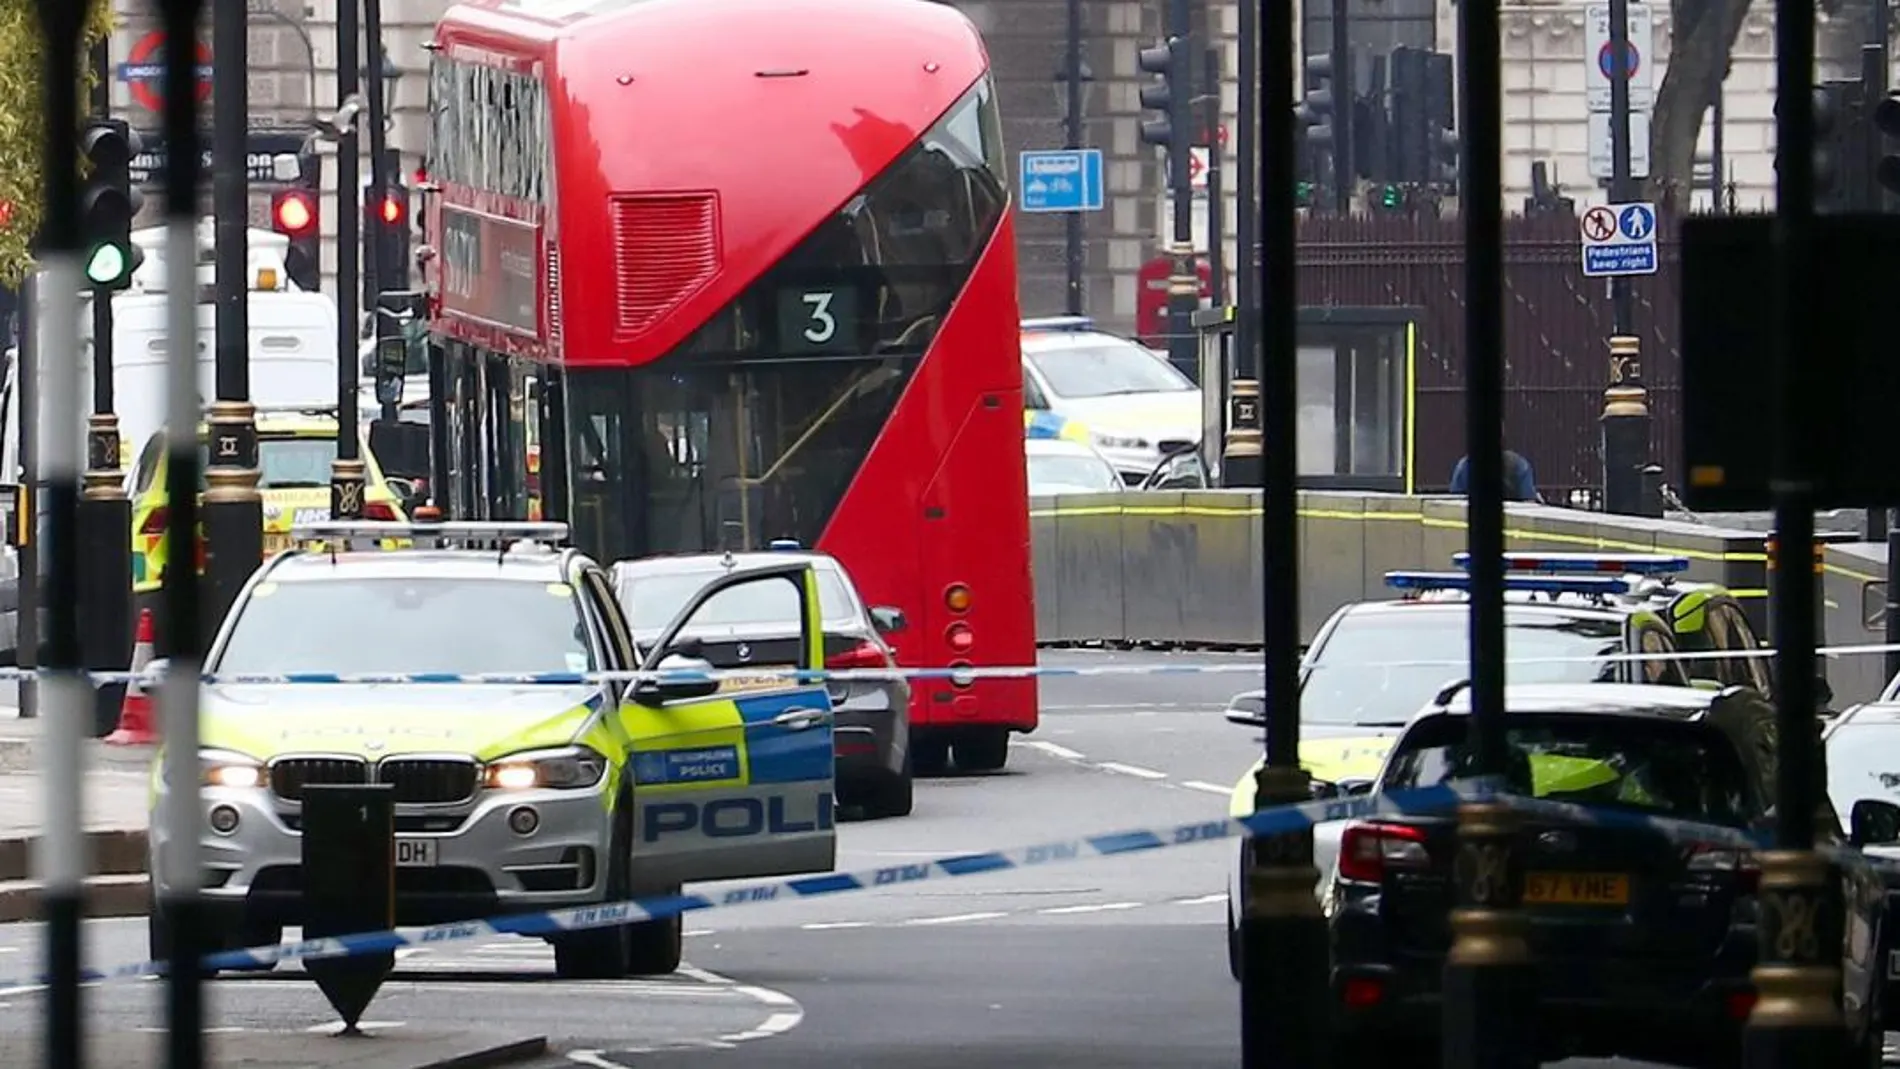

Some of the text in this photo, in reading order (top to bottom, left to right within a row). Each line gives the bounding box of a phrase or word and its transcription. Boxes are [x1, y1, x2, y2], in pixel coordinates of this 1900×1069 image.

[1588, 246, 1651, 258] Pedestrians
[1592, 256, 1648, 270] keep right
[803, 292, 835, 342] 3
[679, 763, 726, 777] POLICE
[643, 791, 833, 843] POLI
[399, 841, 426, 863] DH
